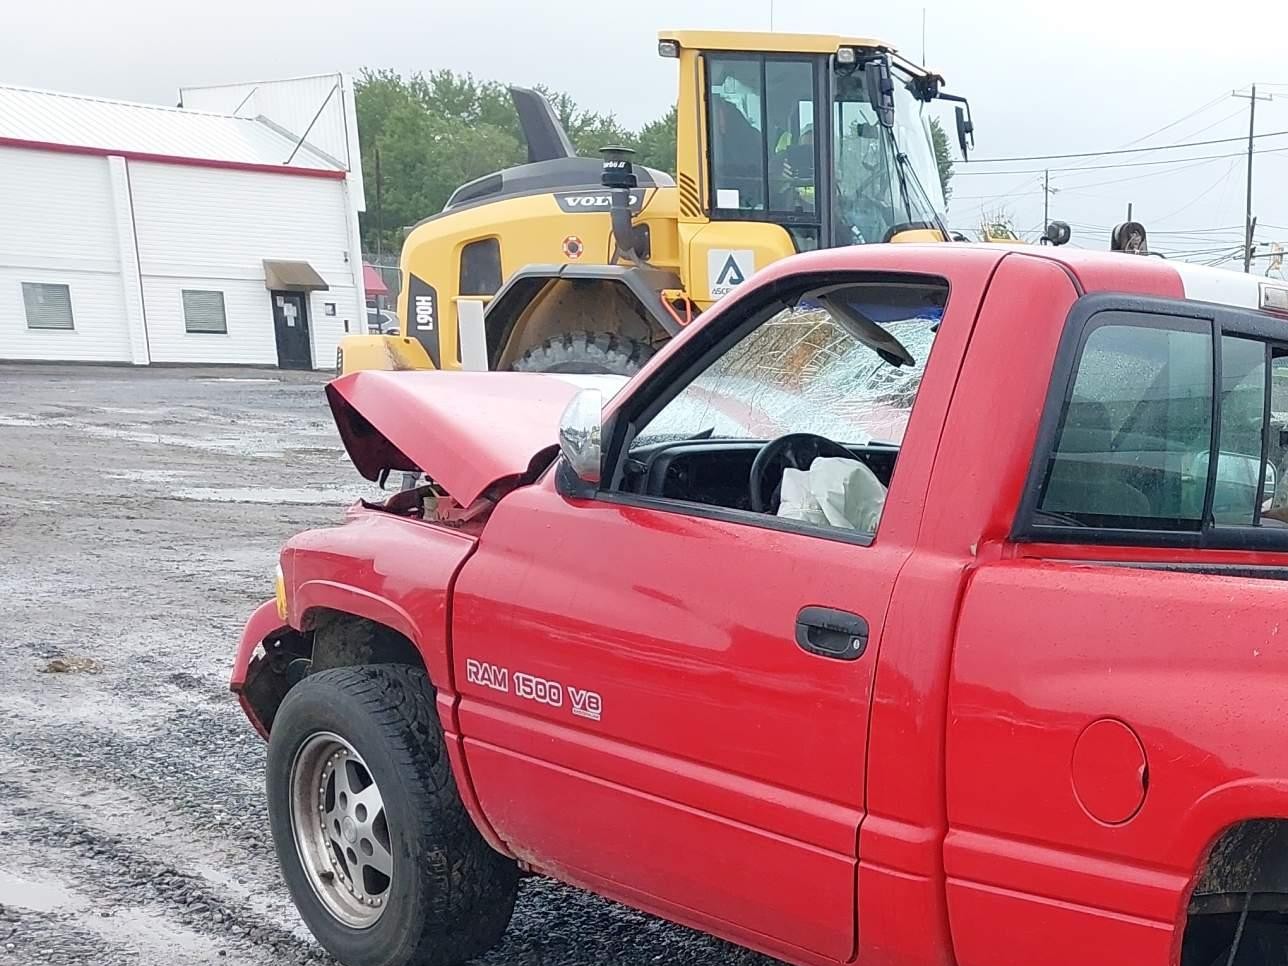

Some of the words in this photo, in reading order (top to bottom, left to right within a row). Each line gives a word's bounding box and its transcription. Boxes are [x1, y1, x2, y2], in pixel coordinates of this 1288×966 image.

[415, 296, 434, 331] L90H
[466, 658, 509, 693] RAM
[512, 672, 563, 707] 1500
[567, 686, 602, 713] V8
